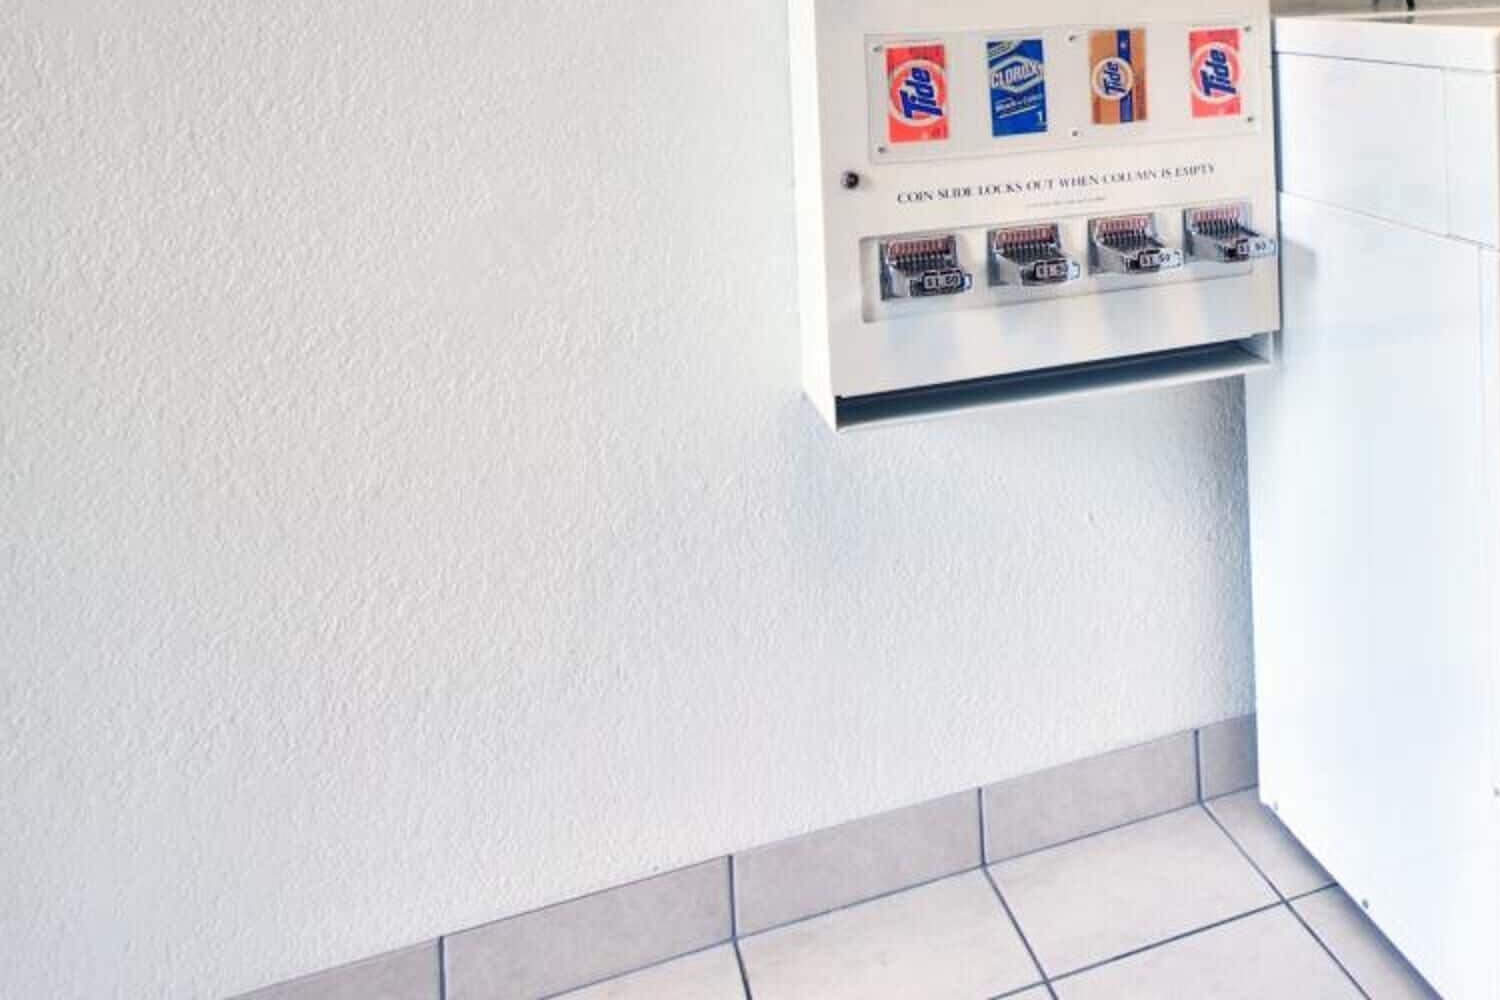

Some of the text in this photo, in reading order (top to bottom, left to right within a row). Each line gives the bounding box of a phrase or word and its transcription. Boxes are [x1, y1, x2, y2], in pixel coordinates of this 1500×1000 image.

[899, 67, 943, 119] Tide
[1102, 61, 1125, 95] Tide
[1200, 49, 1236, 96] Tide
[897, 190, 933, 204] COIN
[937, 186, 972, 201] SLIDE
[977, 182, 1023, 195] LOCKS
[1026, 178, 1054, 191] OUT
[1059, 174, 1099, 188] WHEN
[1161, 167, 1172, 178] IS
[1175, 163, 1215, 176] EMPTY
